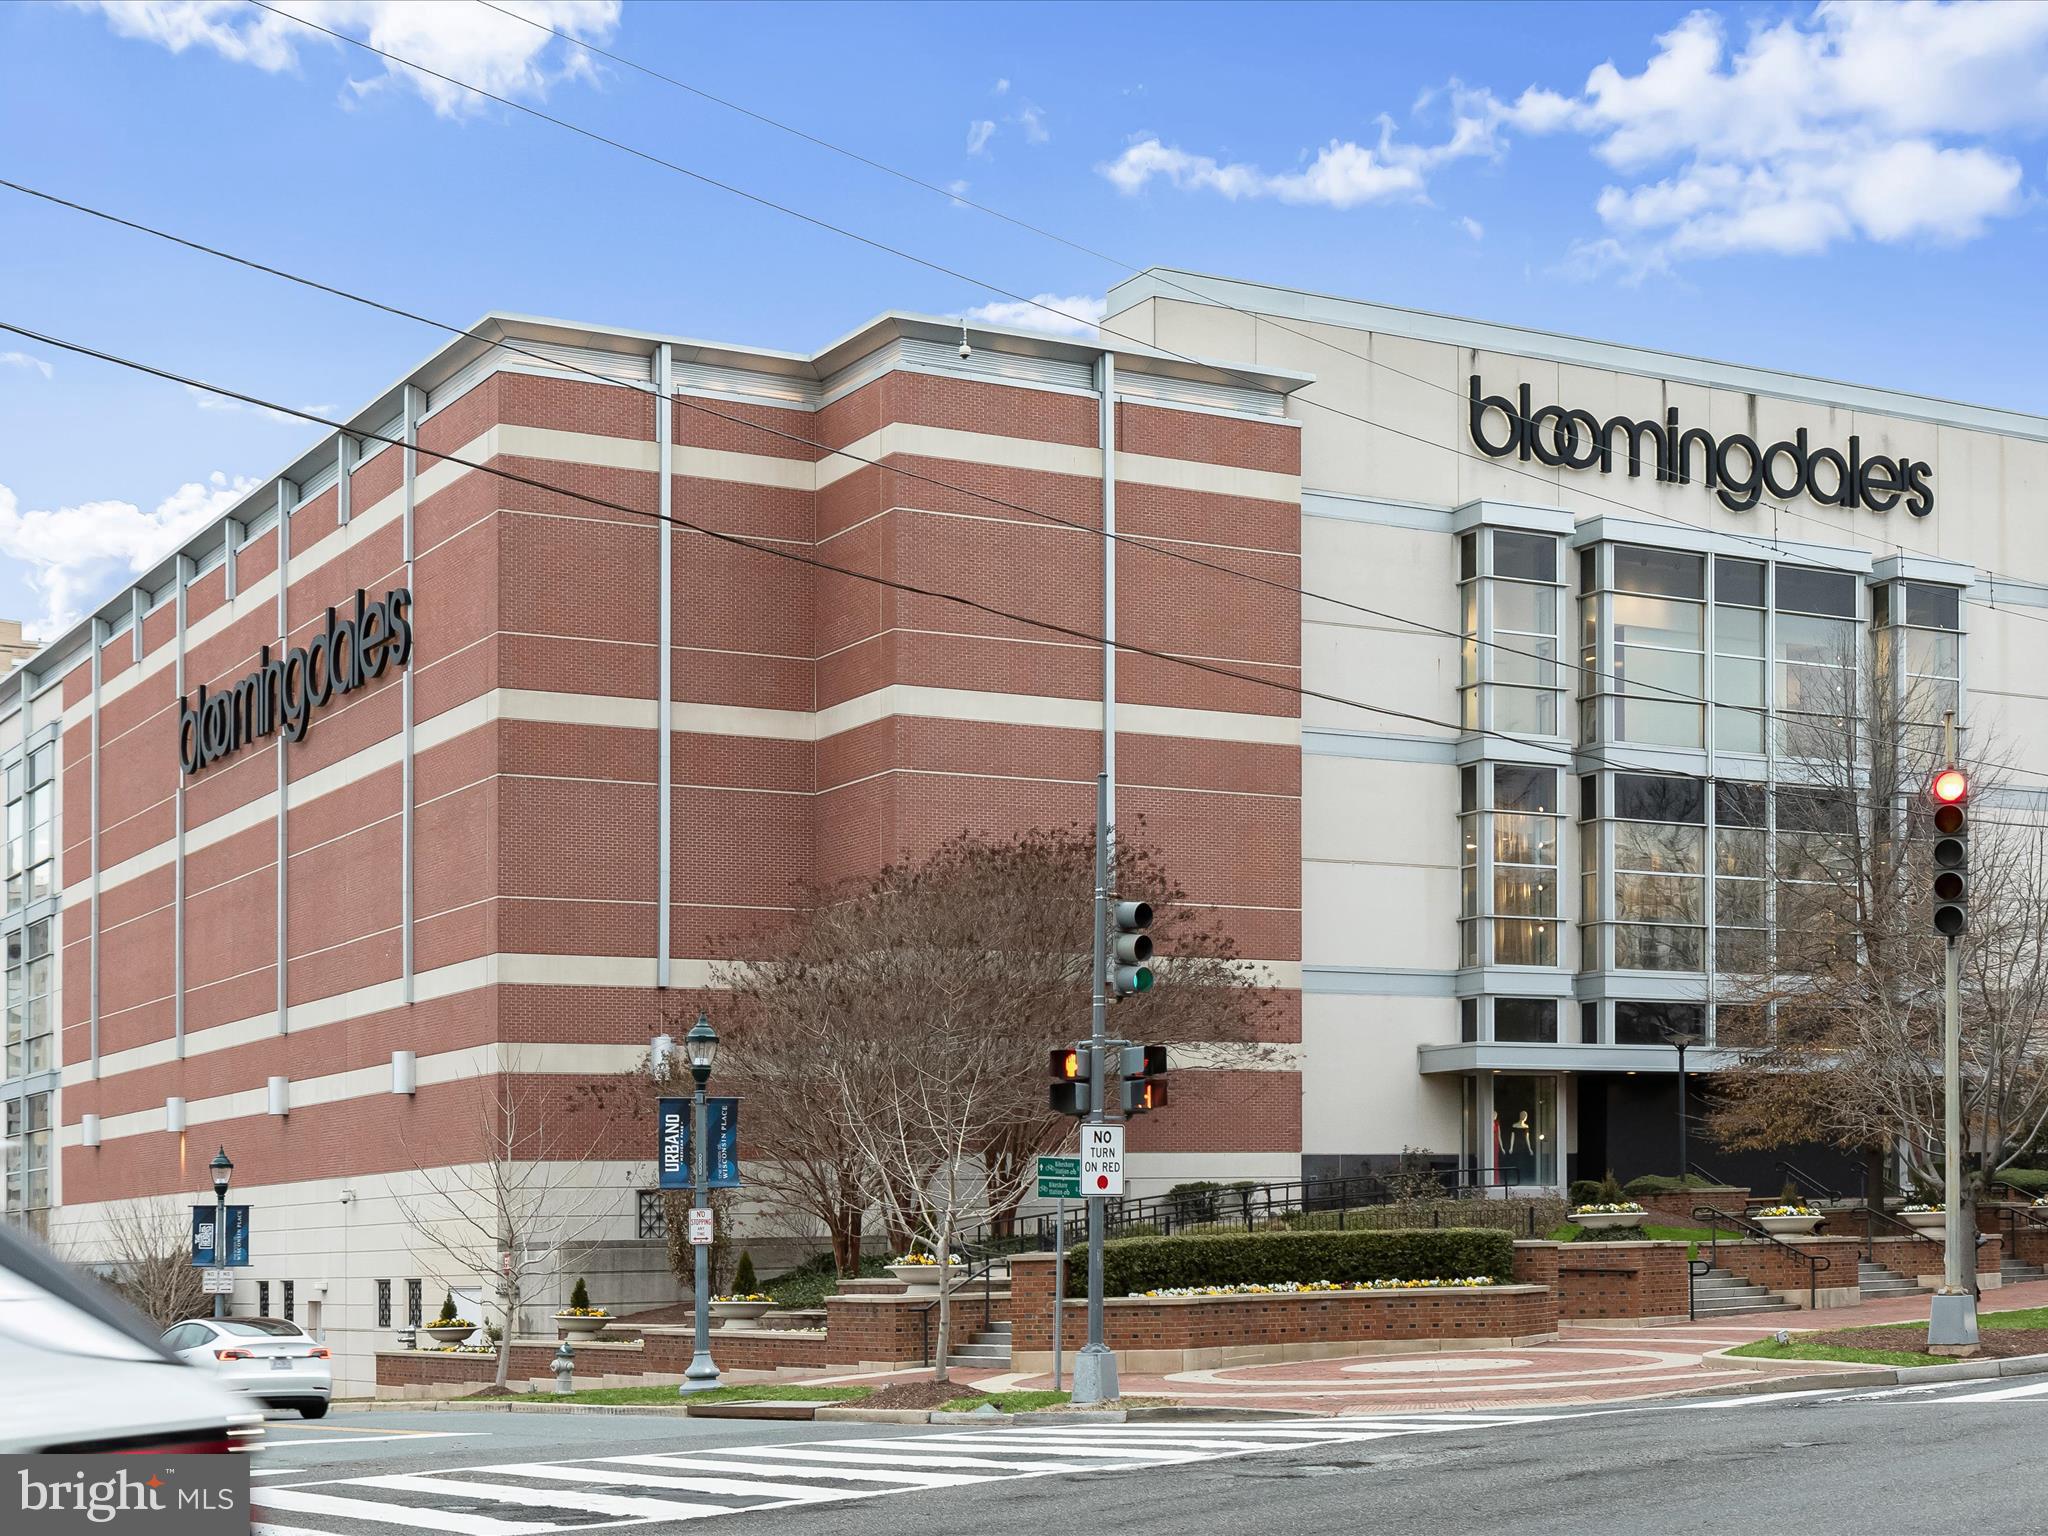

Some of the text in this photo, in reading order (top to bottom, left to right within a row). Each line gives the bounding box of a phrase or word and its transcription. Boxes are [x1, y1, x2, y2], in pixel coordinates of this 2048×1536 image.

[664, 1114, 680, 1172] URBANO
[1093, 1130, 1112, 1144] NO
[1090, 1147, 1115, 1158] TURN
[1084, 1161, 1098, 1173] ON
[1102, 1161, 1121, 1173] RED
